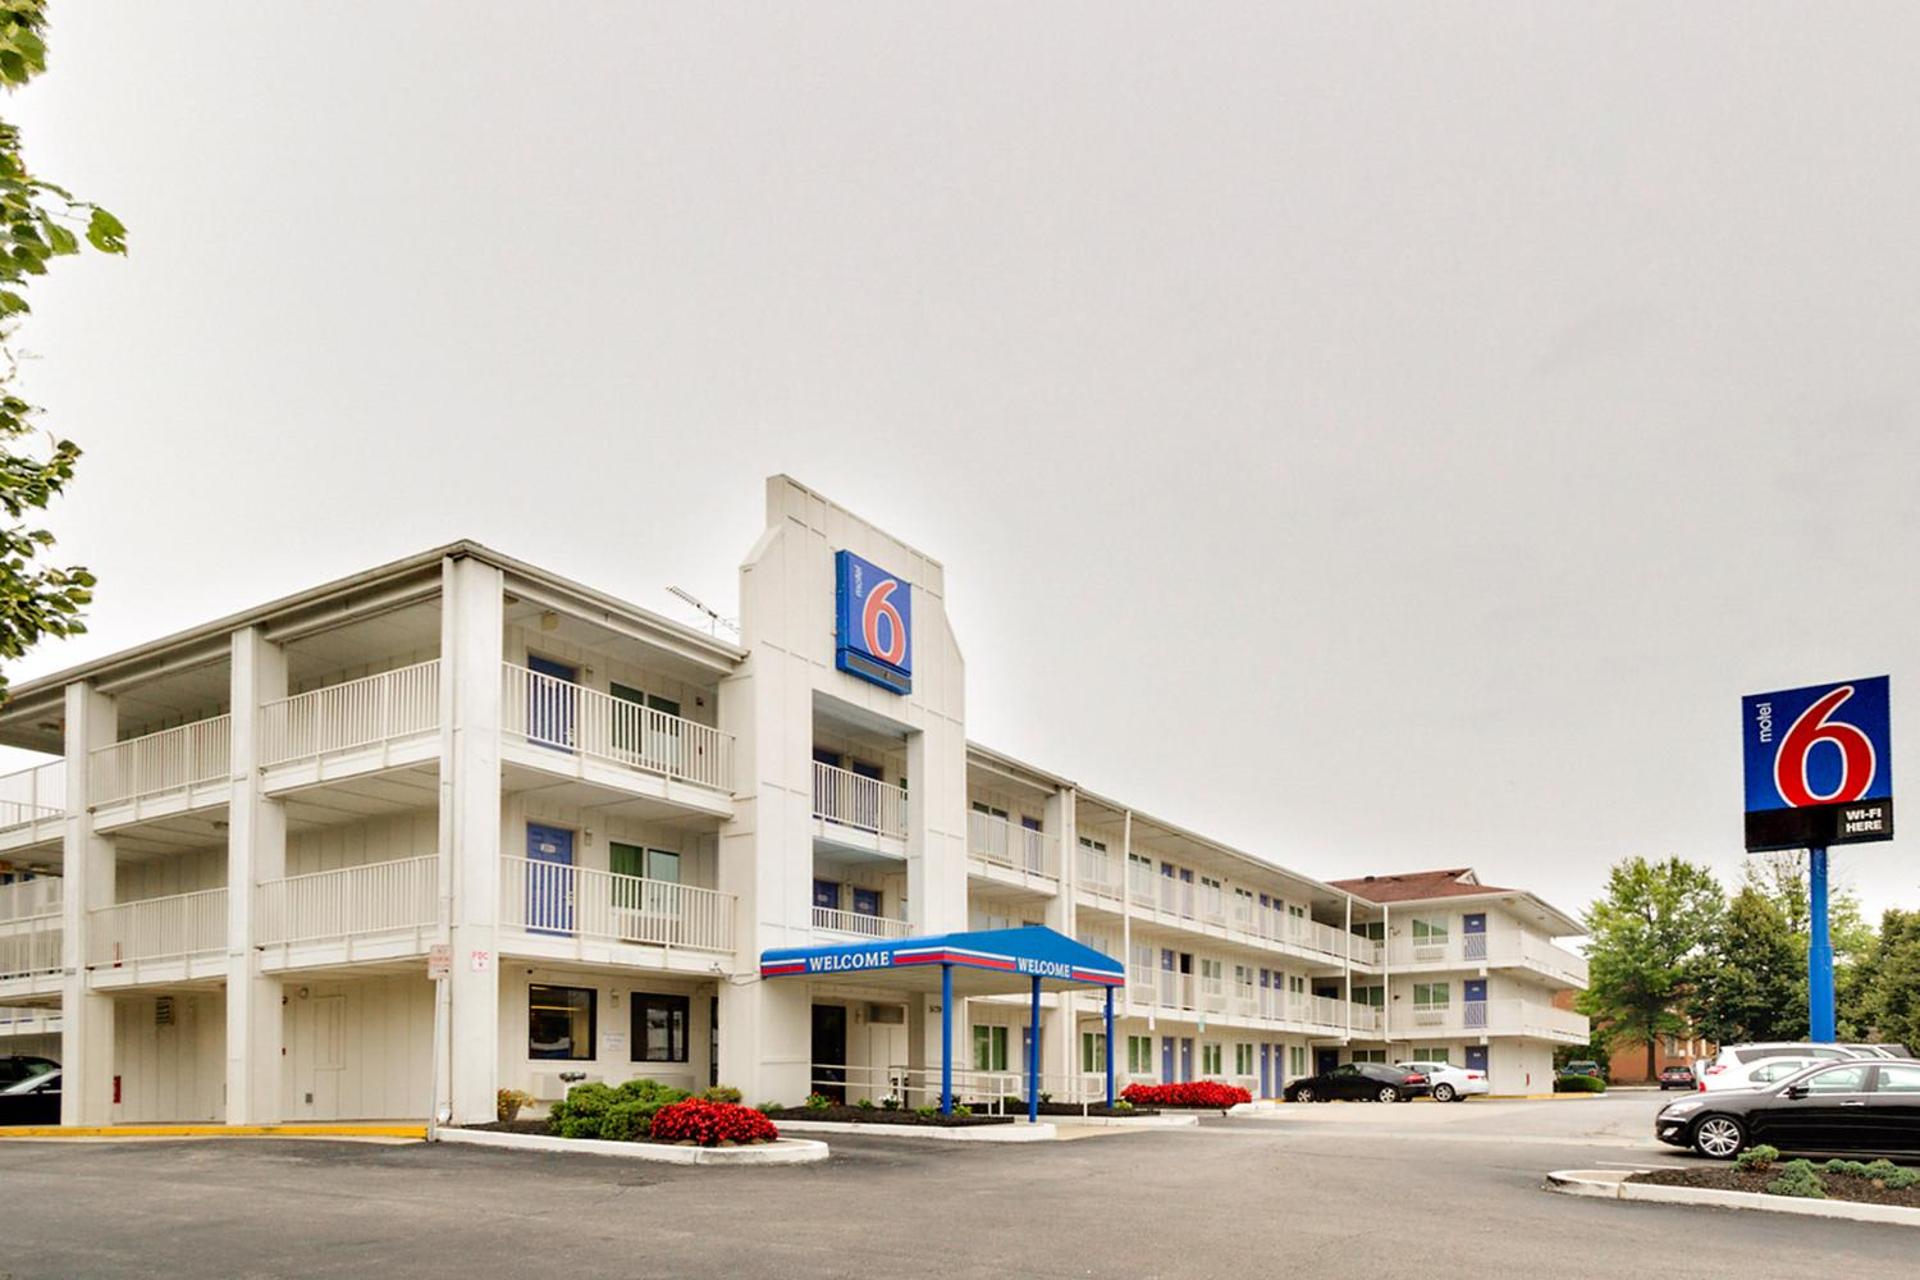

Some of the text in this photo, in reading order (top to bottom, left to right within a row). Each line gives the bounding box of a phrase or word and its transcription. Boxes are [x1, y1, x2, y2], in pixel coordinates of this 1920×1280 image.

[863, 580, 905, 665] 6
[1756, 702, 1772, 743] motel
[1774, 686, 1876, 807] 6
[1846, 808, 1882, 820] WI-FI
[1846, 820, 1883, 832] HERE
[809, 951, 890, 971] WELCOME
[1018, 957, 1071, 978] WELCOME
